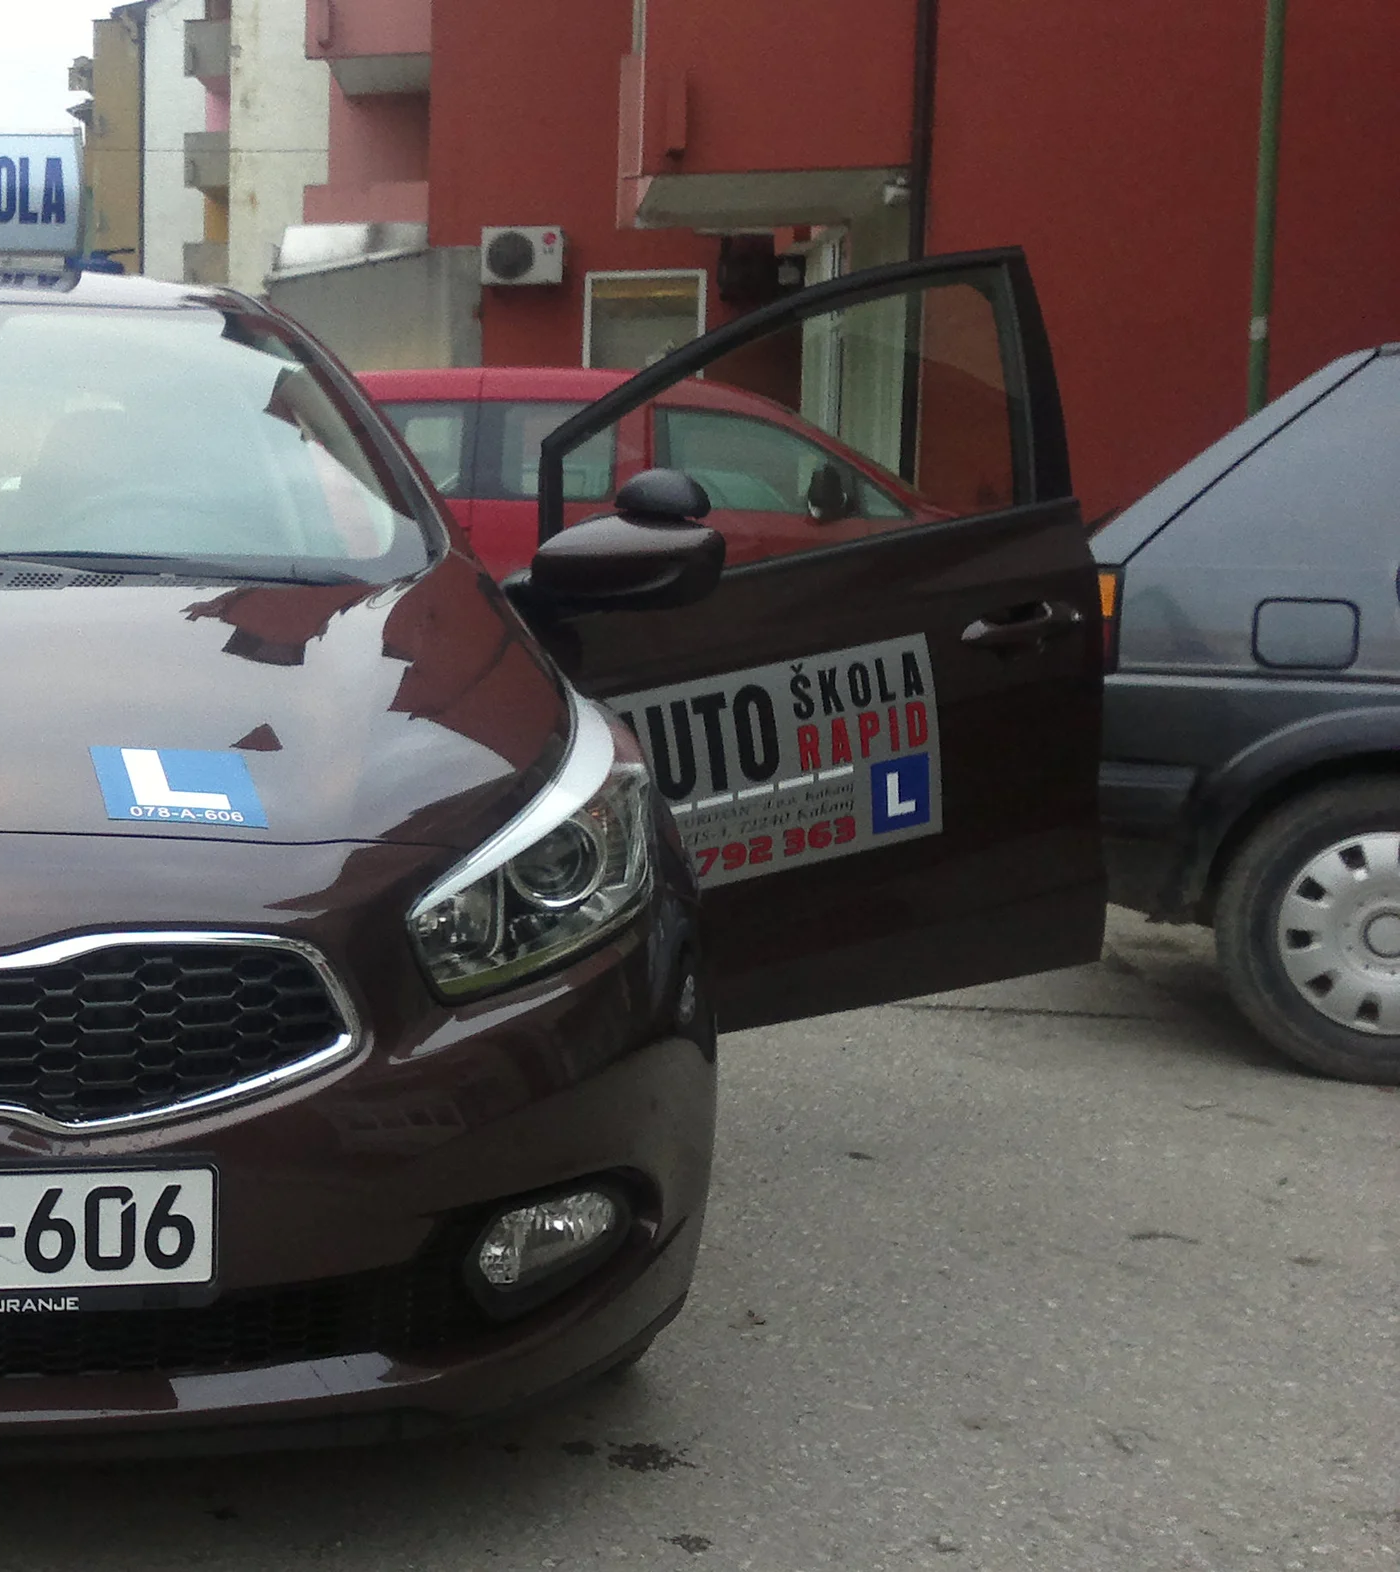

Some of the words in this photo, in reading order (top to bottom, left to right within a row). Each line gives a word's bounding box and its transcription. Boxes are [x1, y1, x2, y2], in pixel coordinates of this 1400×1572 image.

[618, 684, 780, 801] UTO
[789, 651, 925, 721] ŠKOLA
[797, 700, 929, 771] RAPID
[120, 748, 232, 810] L
[886, 772, 916, 818] L
[129, 805, 244, 822] 078-A-606
[696, 836, 773, 877] 792
[783, 815, 856, 858] 363
